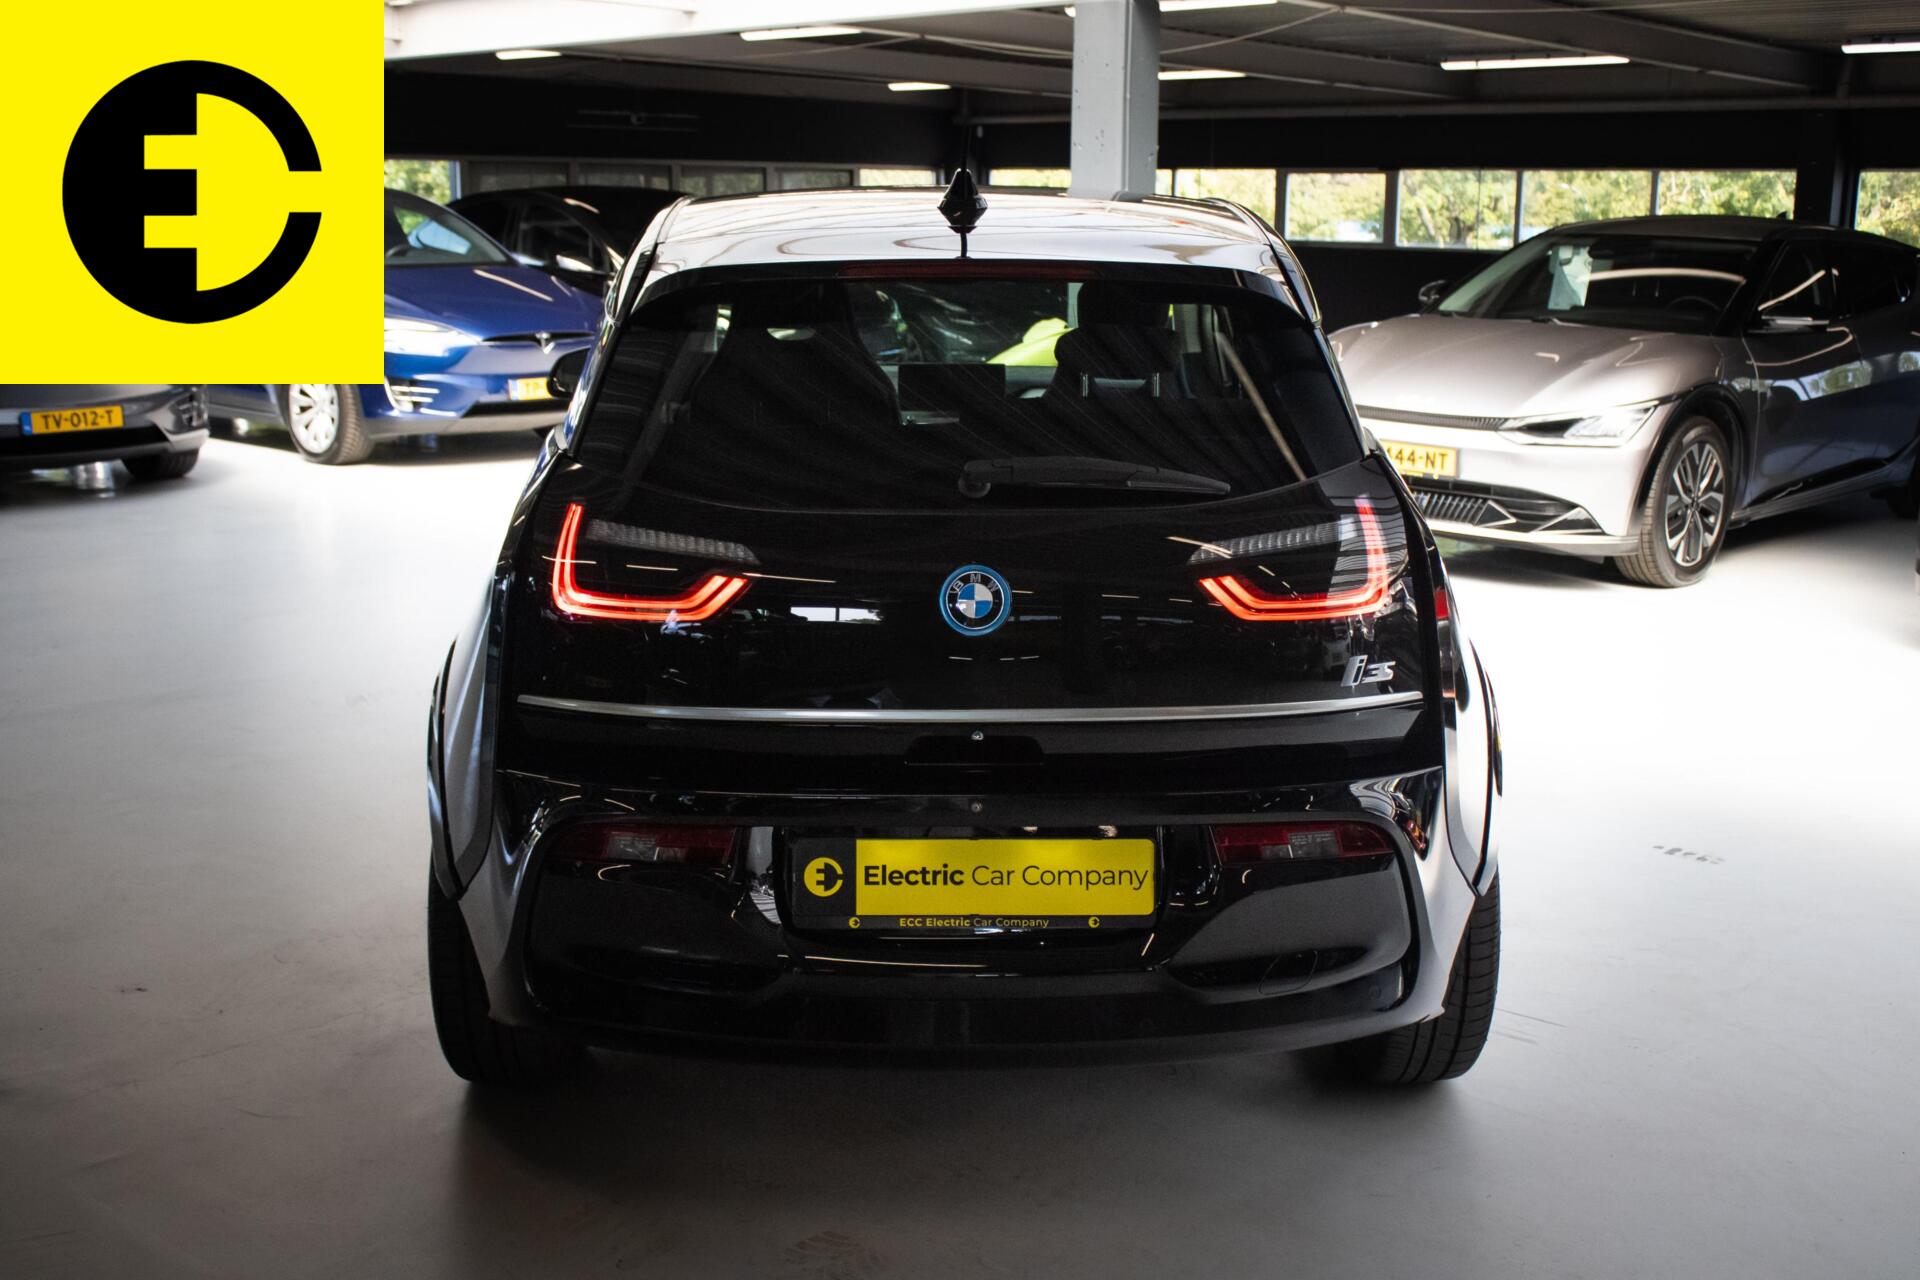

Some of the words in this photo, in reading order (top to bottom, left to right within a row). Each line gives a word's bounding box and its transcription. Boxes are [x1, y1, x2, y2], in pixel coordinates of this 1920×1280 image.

[41, 409, 114, 430] TV-012-T
[950, 573, 999, 593] BMW
[863, 863, 965, 886] Electric
[972, 865, 1015, 886] Car
[1022, 865, 1149, 891] Company
[899, 917, 923, 927] ECC
[926, 917, 971, 927] Electric
[973, 917, 992, 927] Car
[995, 917, 1050, 929] Company
